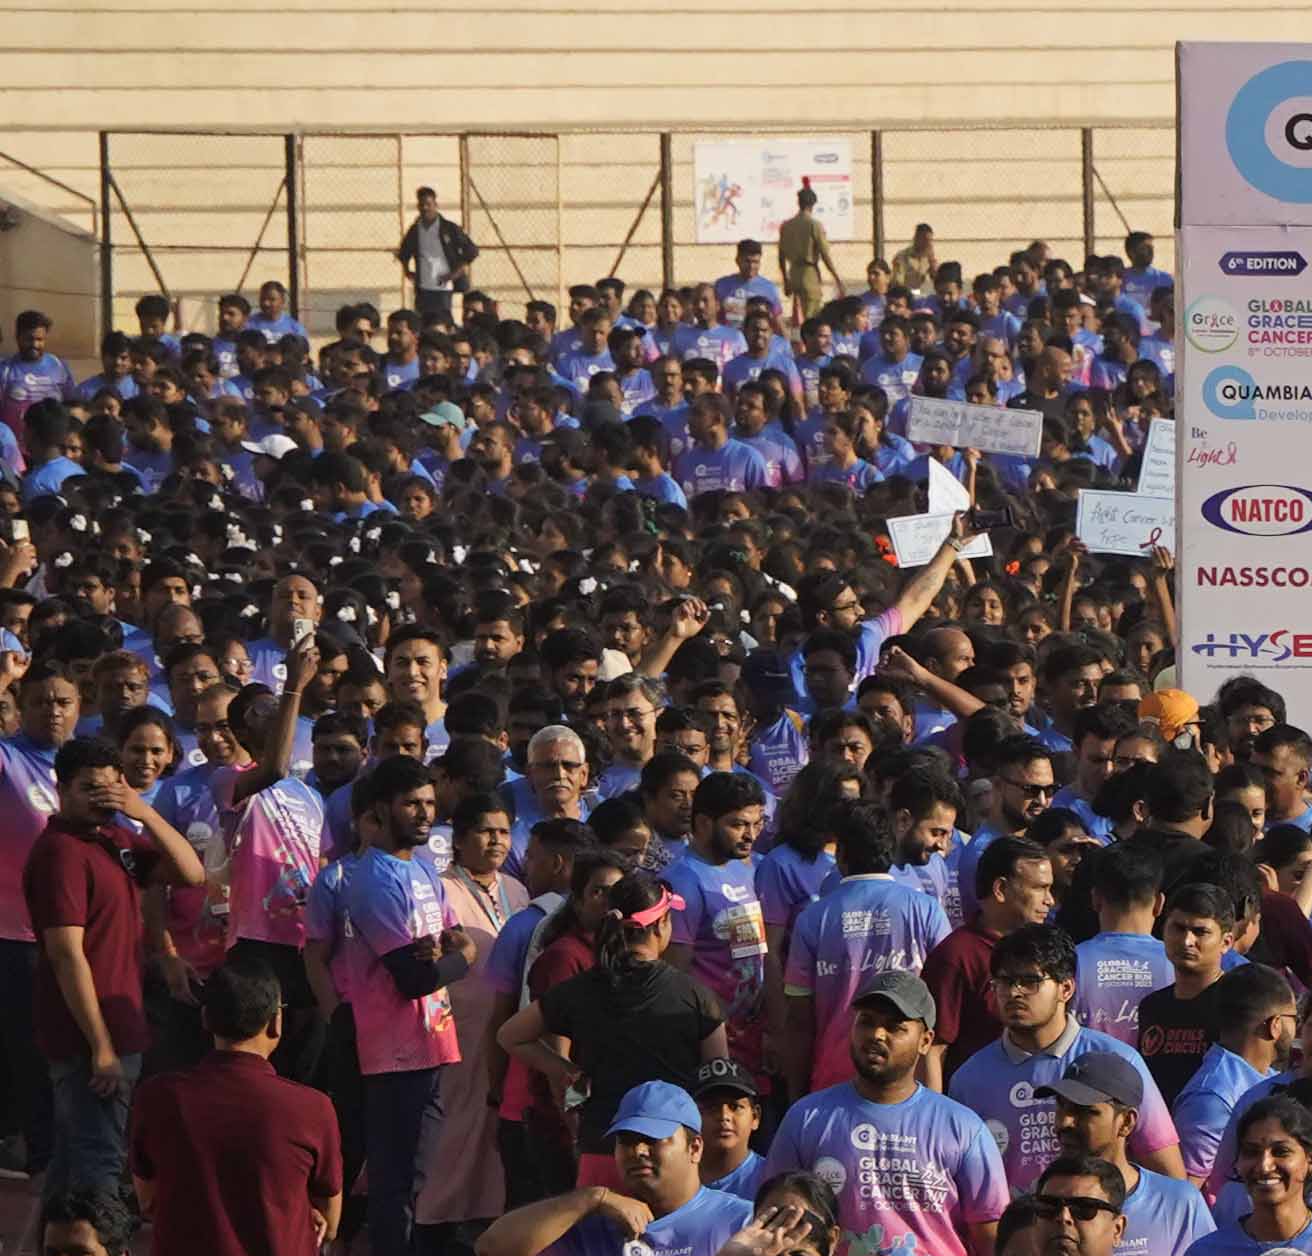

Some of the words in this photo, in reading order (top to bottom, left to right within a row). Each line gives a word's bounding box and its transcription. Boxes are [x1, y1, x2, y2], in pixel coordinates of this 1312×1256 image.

[1228, 258, 1244, 270] 6th
[1247, 258, 1297, 270] EDITION
[1191, 427, 1208, 439] Be
[1187, 448, 1226, 467] Light
[1231, 498, 1304, 522] NATCO
[699, 1059, 737, 1080] BOY
[1020, 1111, 1057, 1126] GLOB
[1020, 1126, 1057, 1140] GRAC
[1020, 1139, 1061, 1155] CANC
[860, 1156, 919, 1171] GLOBAL
[860, 1184, 919, 1199] CANCER
